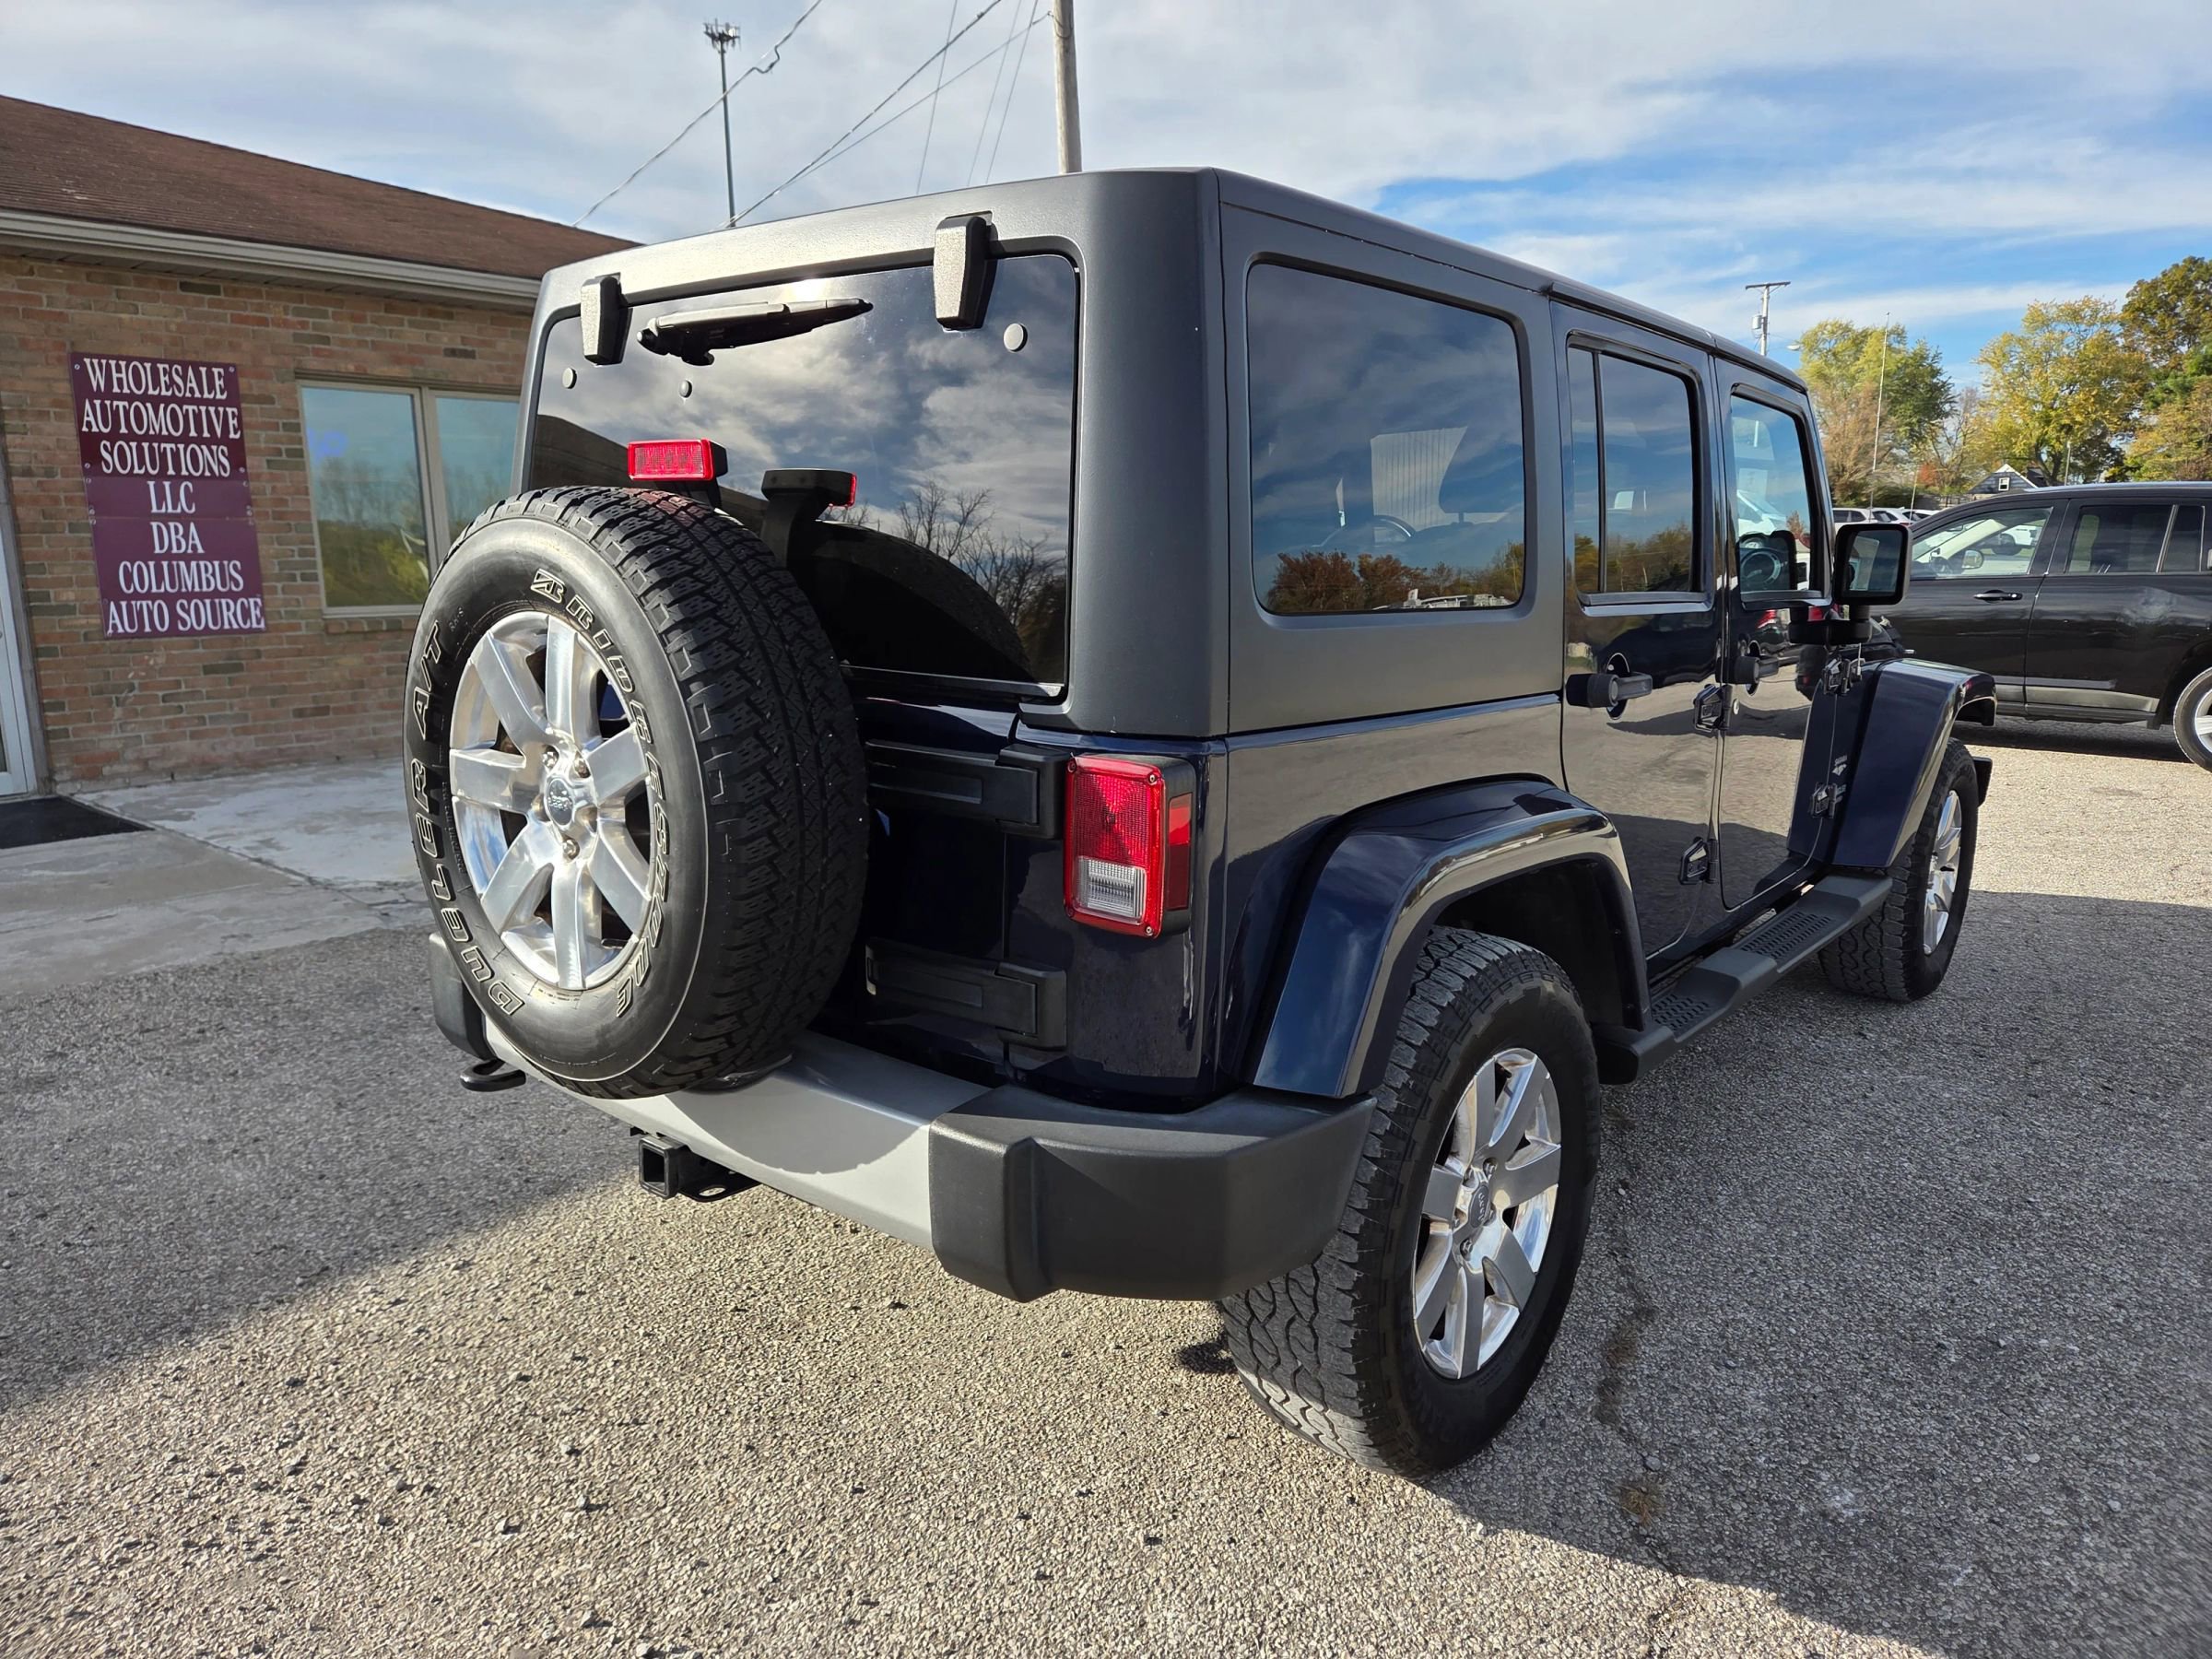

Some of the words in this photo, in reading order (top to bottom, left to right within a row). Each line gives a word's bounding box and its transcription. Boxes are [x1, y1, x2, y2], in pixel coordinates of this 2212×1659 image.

[84, 358, 227, 399] WHOLESALE
[82, 399, 241, 439] AUTOMOTIVE
[100, 441, 230, 477] SOLUTIONS
[147, 481, 195, 513] LLC
[150, 522, 205, 553] DBA
[119, 560, 243, 593] COLUMBUS
[108, 601, 170, 633] AUTO
[177, 597, 265, 629] SOURCE
[413, 619, 442, 740] A/T
[530, 569, 670, 1018] BRIDGESTONE
[411, 758, 525, 1015] DUELER
